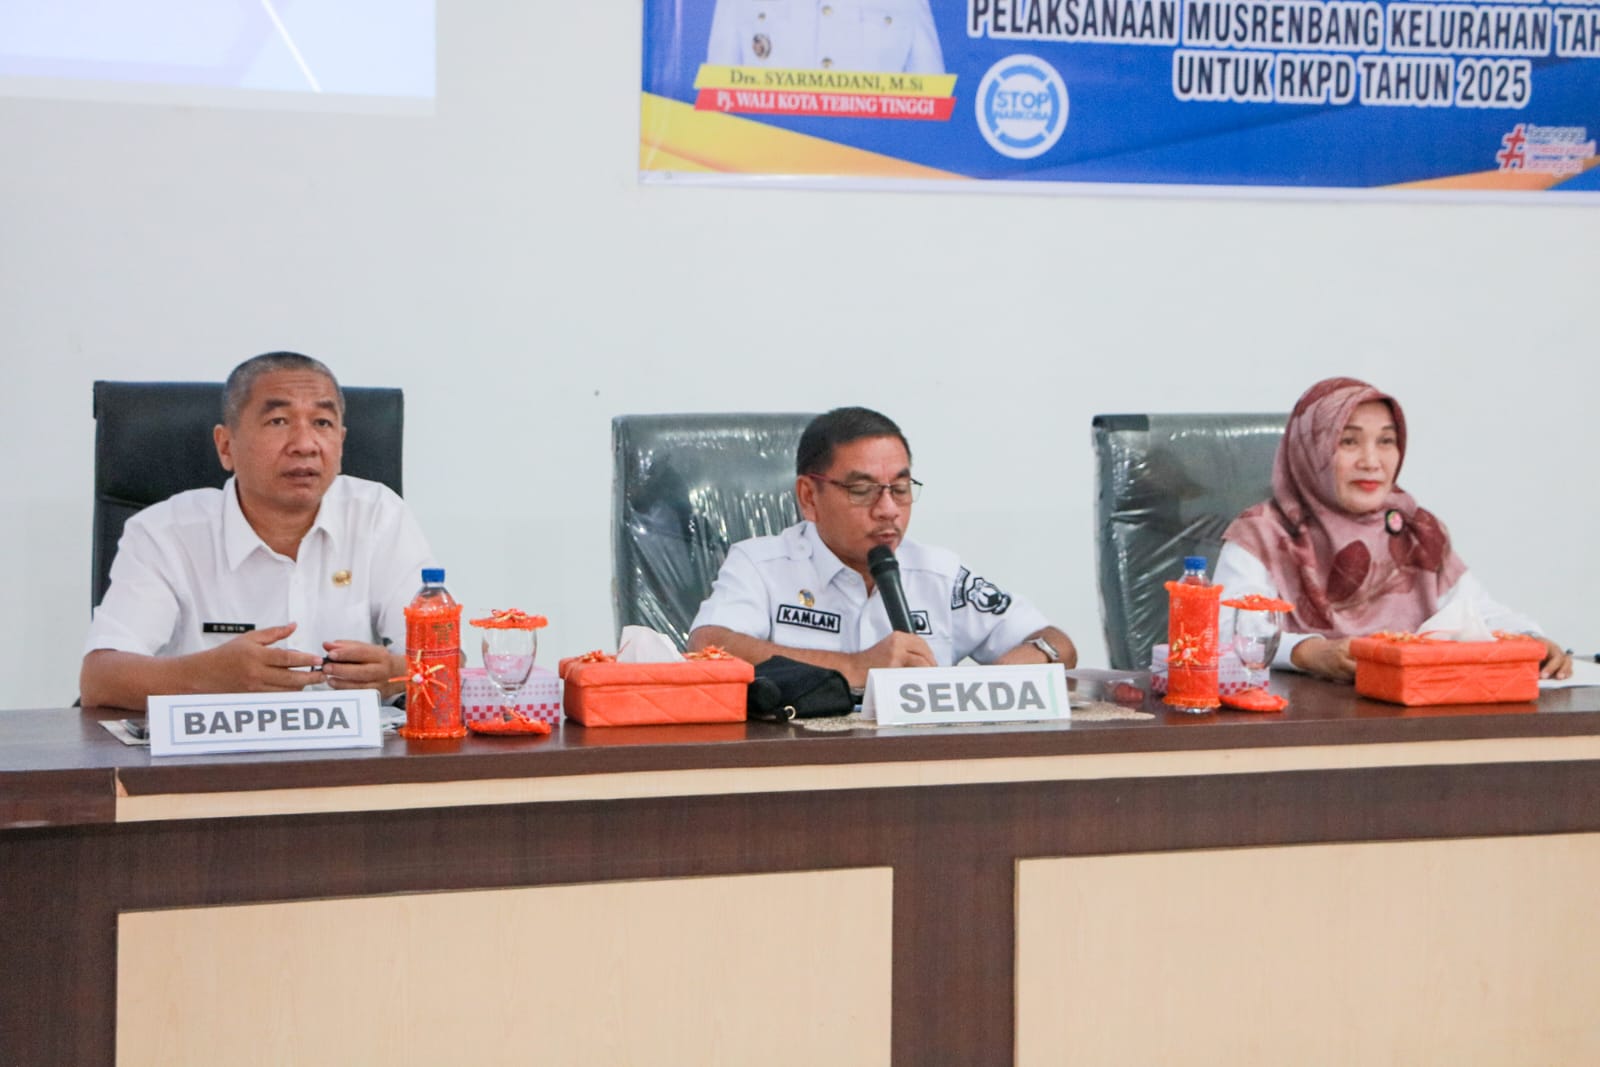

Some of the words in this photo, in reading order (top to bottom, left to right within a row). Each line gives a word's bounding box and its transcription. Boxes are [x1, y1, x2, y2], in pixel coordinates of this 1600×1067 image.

[972, 0, 1175, 39] PELAKSANAAN
[1187, 1, 1378, 46] MUSRENBANG
[1390, 10, 1547, 50] KELURAHAN
[764, 71, 885, 91] SYARMADANI,
[889, 77, 923, 91] M.Si
[1179, 55, 1270, 96] UNTUK
[1279, 60, 1350, 98] RKPD
[1362, 62, 1449, 101] TAHUN
[1461, 65, 1526, 102] 2025
[736, 91, 775, 108] WALI
[778, 93, 818, 110] KOTA
[822, 95, 877, 112] TEBING
[881, 98, 935, 115] TINGGI
[997, 91, 1048, 108] STOP
[213, 624, 245, 632] ERWIN
[782, 608, 836, 629] KAMLAN
[899, 680, 1046, 714] SEKDA
[184, 707, 350, 735] BAPPEDA
